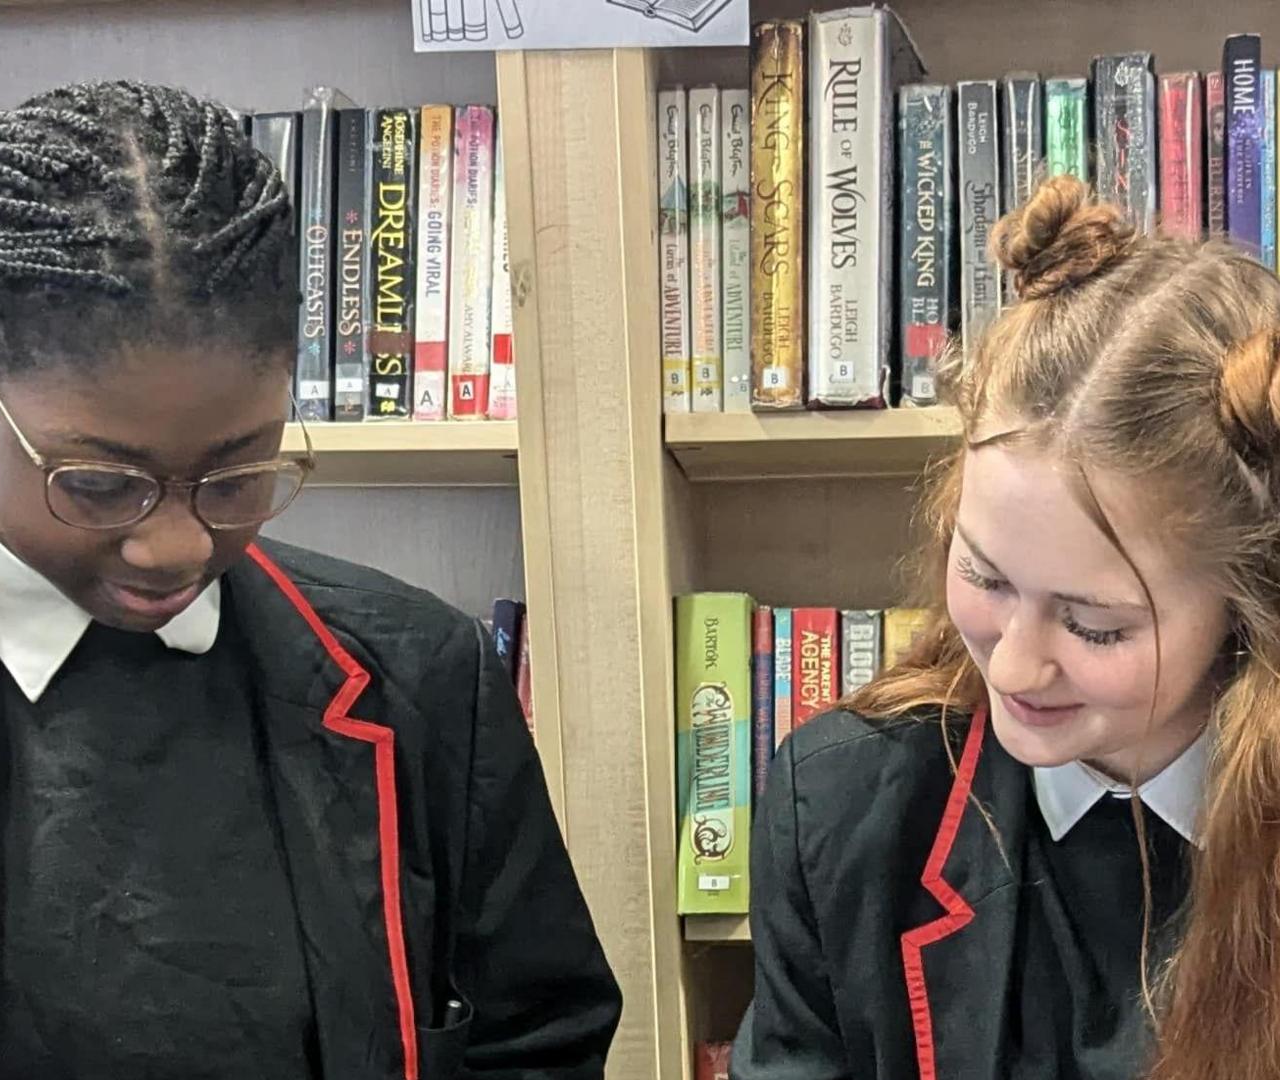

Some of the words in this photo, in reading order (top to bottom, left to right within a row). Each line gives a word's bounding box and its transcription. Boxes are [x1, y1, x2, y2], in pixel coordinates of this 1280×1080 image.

[757, 71, 794, 151] KING
[823, 57, 862, 133] RULE
[1233, 58, 1256, 115] HOME
[380, 114, 394, 170] ANGELINI
[393, 113, 408, 176] JOSEPHINE
[839, 139, 853, 160] OF
[966, 102, 979, 155] BARDUGO
[978, 112, 989, 143] LEIGH
[825, 165, 867, 270] WOLVES
[917, 151, 935, 231] WICKED
[426, 210, 442, 254] GOING
[756, 178, 795, 278] SCARS
[302, 224, 330, 338] OUTCASTS
[339, 228, 363, 336] ENDLESS
[370, 180, 407, 376] DREAMLS
[424, 256, 441, 298] VIRAL
[912, 235, 936, 287] KING
[662, 285, 683, 357] ADVENTURE
[726, 283, 743, 353] ADVENTURE
[761, 291, 775, 366] BARDUGO
[778, 306, 790, 349] LEIGH
[829, 283, 843, 359] BARDUGO
[845, 298, 859, 343] LEIGH
[462, 382, 472, 397] A
[671, 372, 680, 386] B
[702, 366, 711, 380] B
[770, 371, 779, 386] B
[839, 364, 849, 377] B
[420, 390, 433, 406] A
[775, 637, 792, 681] BLADE
[800, 630, 820, 709] AGENCY
[820, 635, 832, 659] THE
[820, 660, 832, 704] PARENT
[690, 706, 732, 813] WONDERLING
